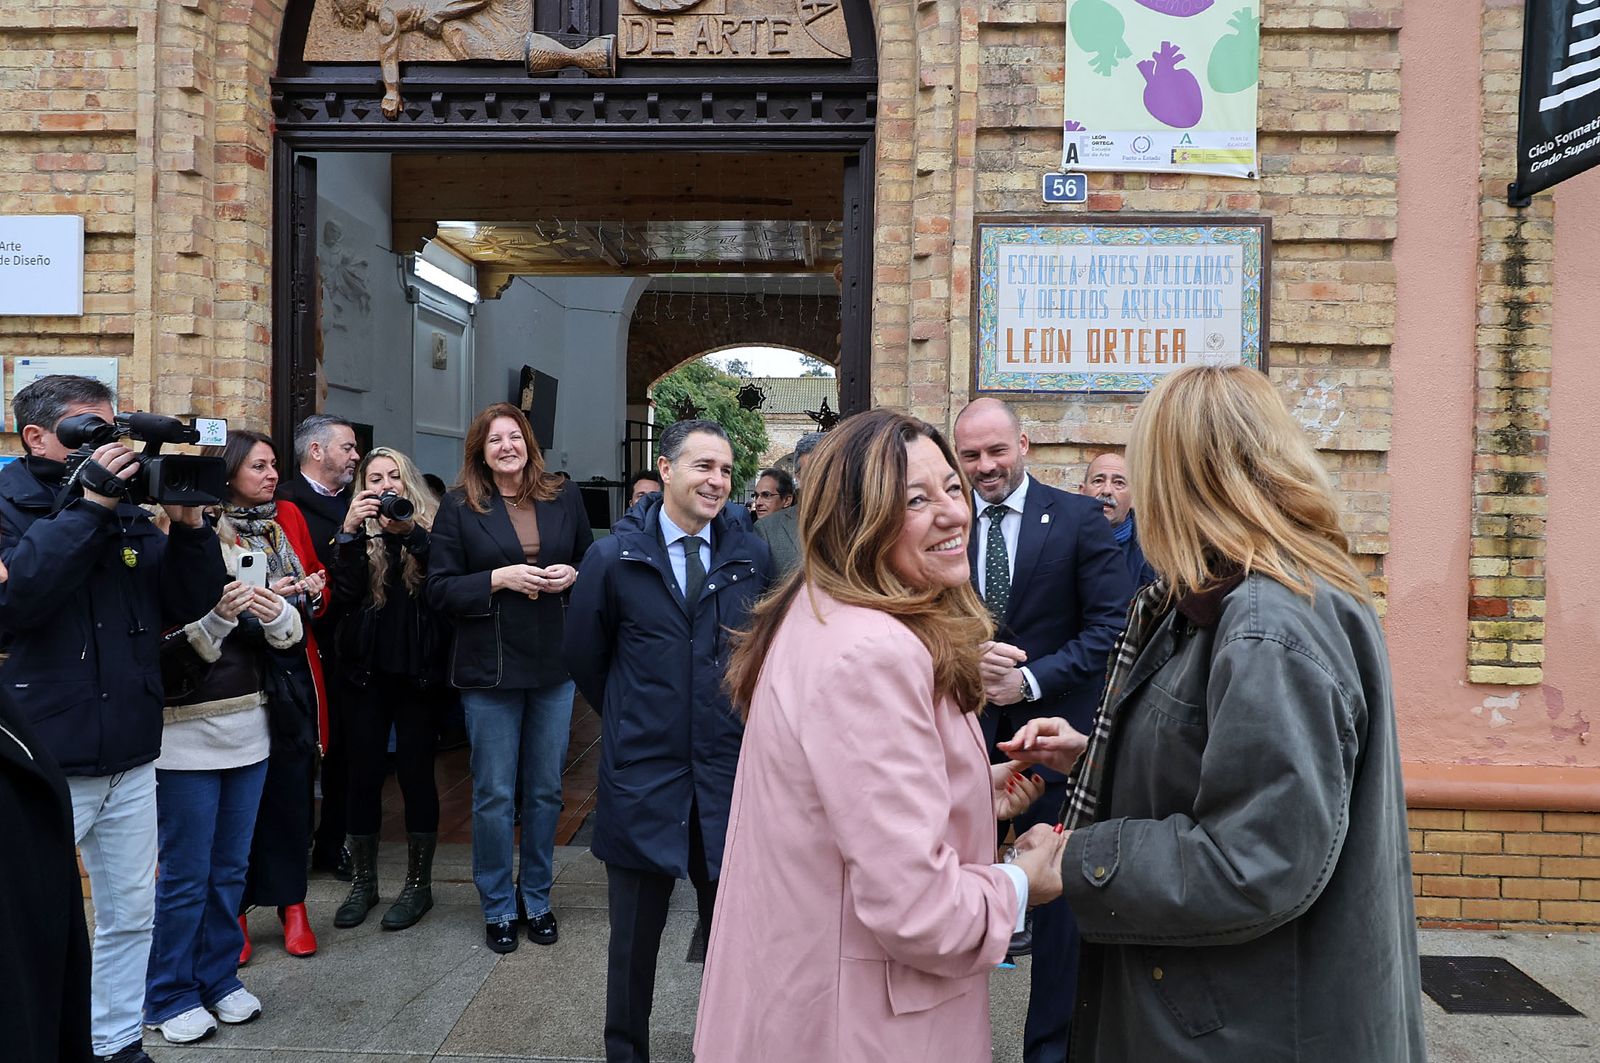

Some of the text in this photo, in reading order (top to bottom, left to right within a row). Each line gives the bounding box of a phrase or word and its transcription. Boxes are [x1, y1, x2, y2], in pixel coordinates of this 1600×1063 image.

[622, 15, 791, 55] DE ARTE
[1528, 141, 1555, 159] Ciclo
[1530, 153, 1562, 173] Grado
[1052, 178, 1077, 197] 56
[0, 241, 21, 251] Arte
[13, 254, 51, 266] Diseño
[1007, 254, 1078, 285] ESCUELA
[1087, 254, 1139, 287] ARTES
[1143, 254, 1234, 285] APLICADAS
[1017, 288, 1224, 322] Y OFICIOS ARTISTICOS
[1086, 328, 1186, 364] ORTEGA
